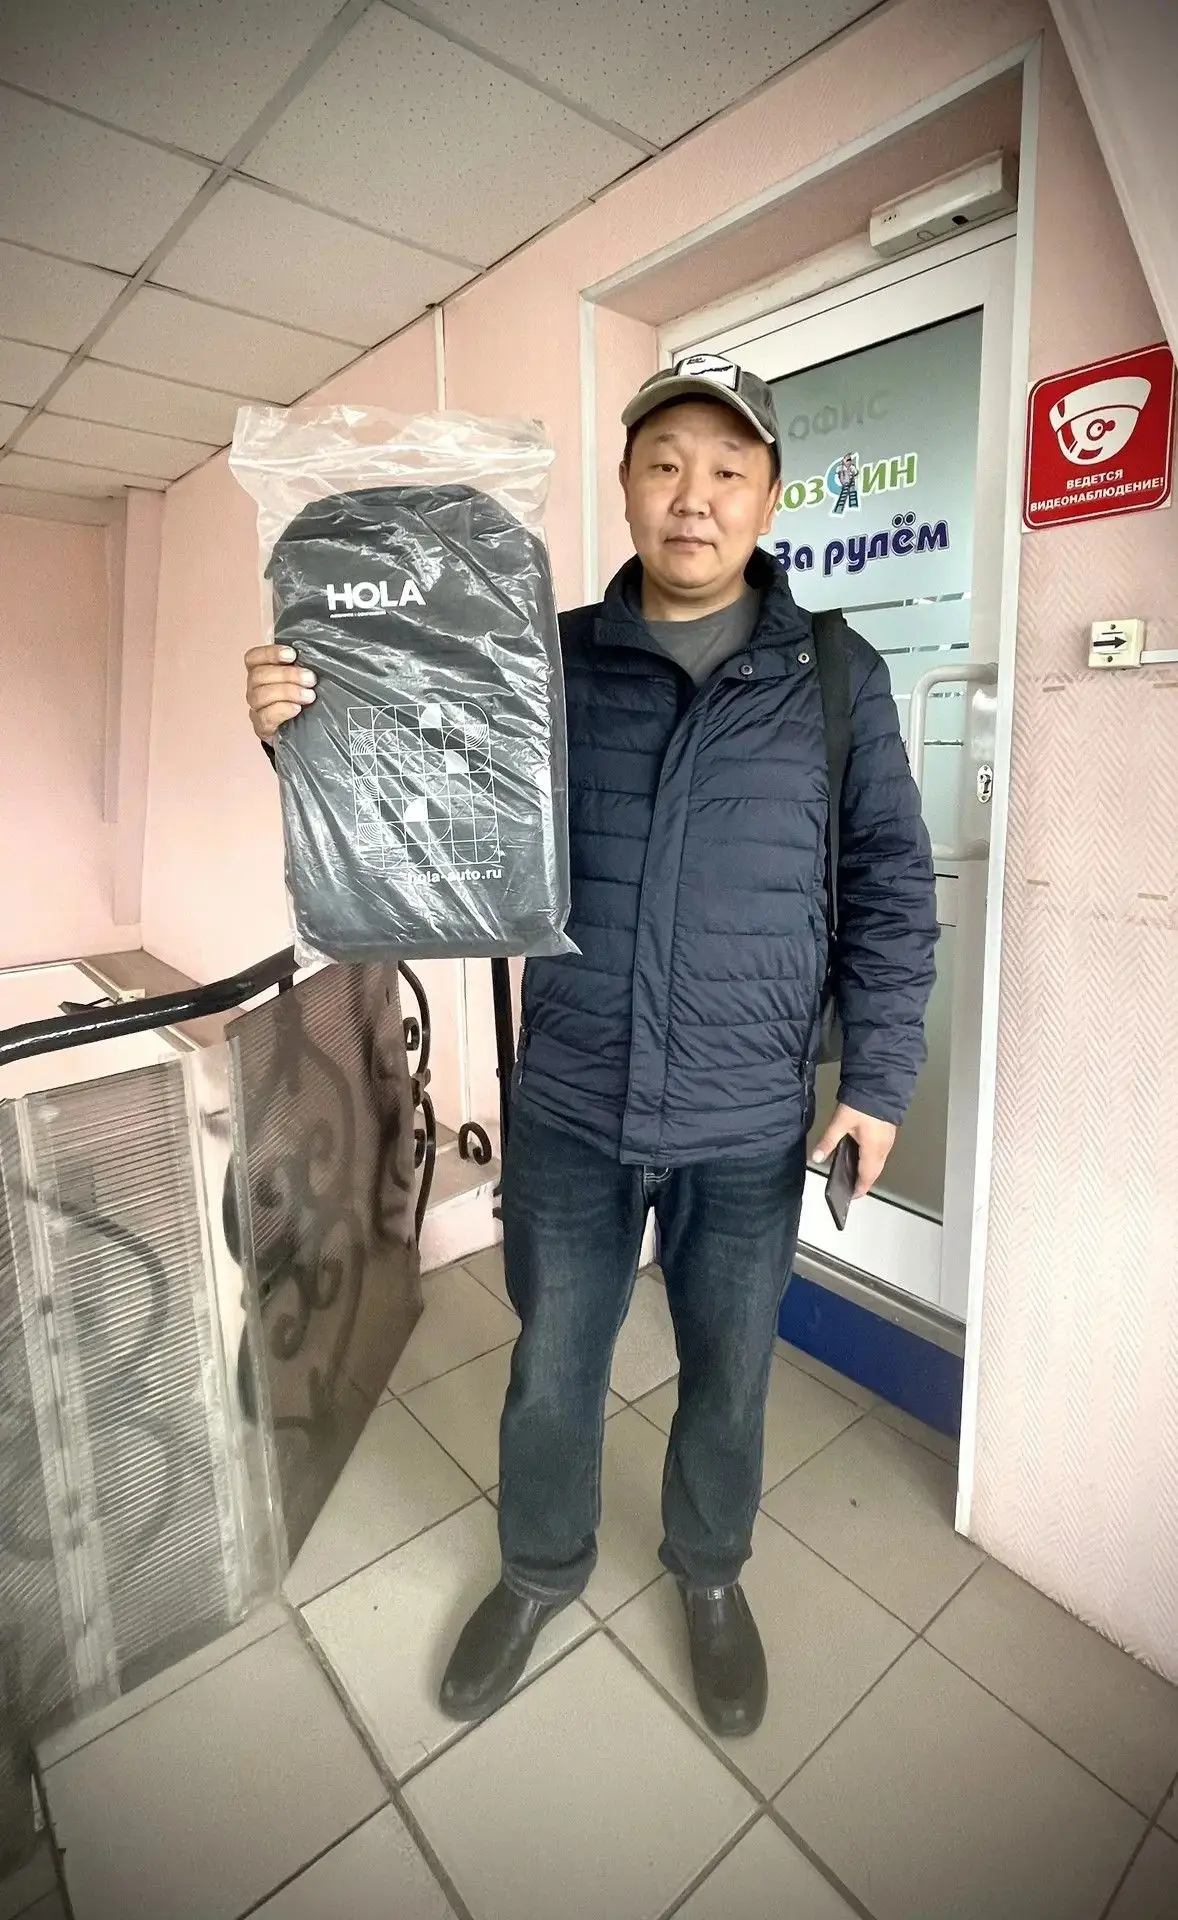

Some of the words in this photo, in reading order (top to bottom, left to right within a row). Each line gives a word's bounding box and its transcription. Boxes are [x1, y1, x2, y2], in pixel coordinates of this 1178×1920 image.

[775, 453, 916, 514] озЯин
[1030, 477, 1164, 512] ВИДЕОНАБЛЮДЕНИЕ!
[1067, 469, 1123, 489] ВЕДЕТСЯ
[774, 540, 813, 572] За
[823, 511, 949, 577] рулём
[326, 579, 426, 611] HOLA
